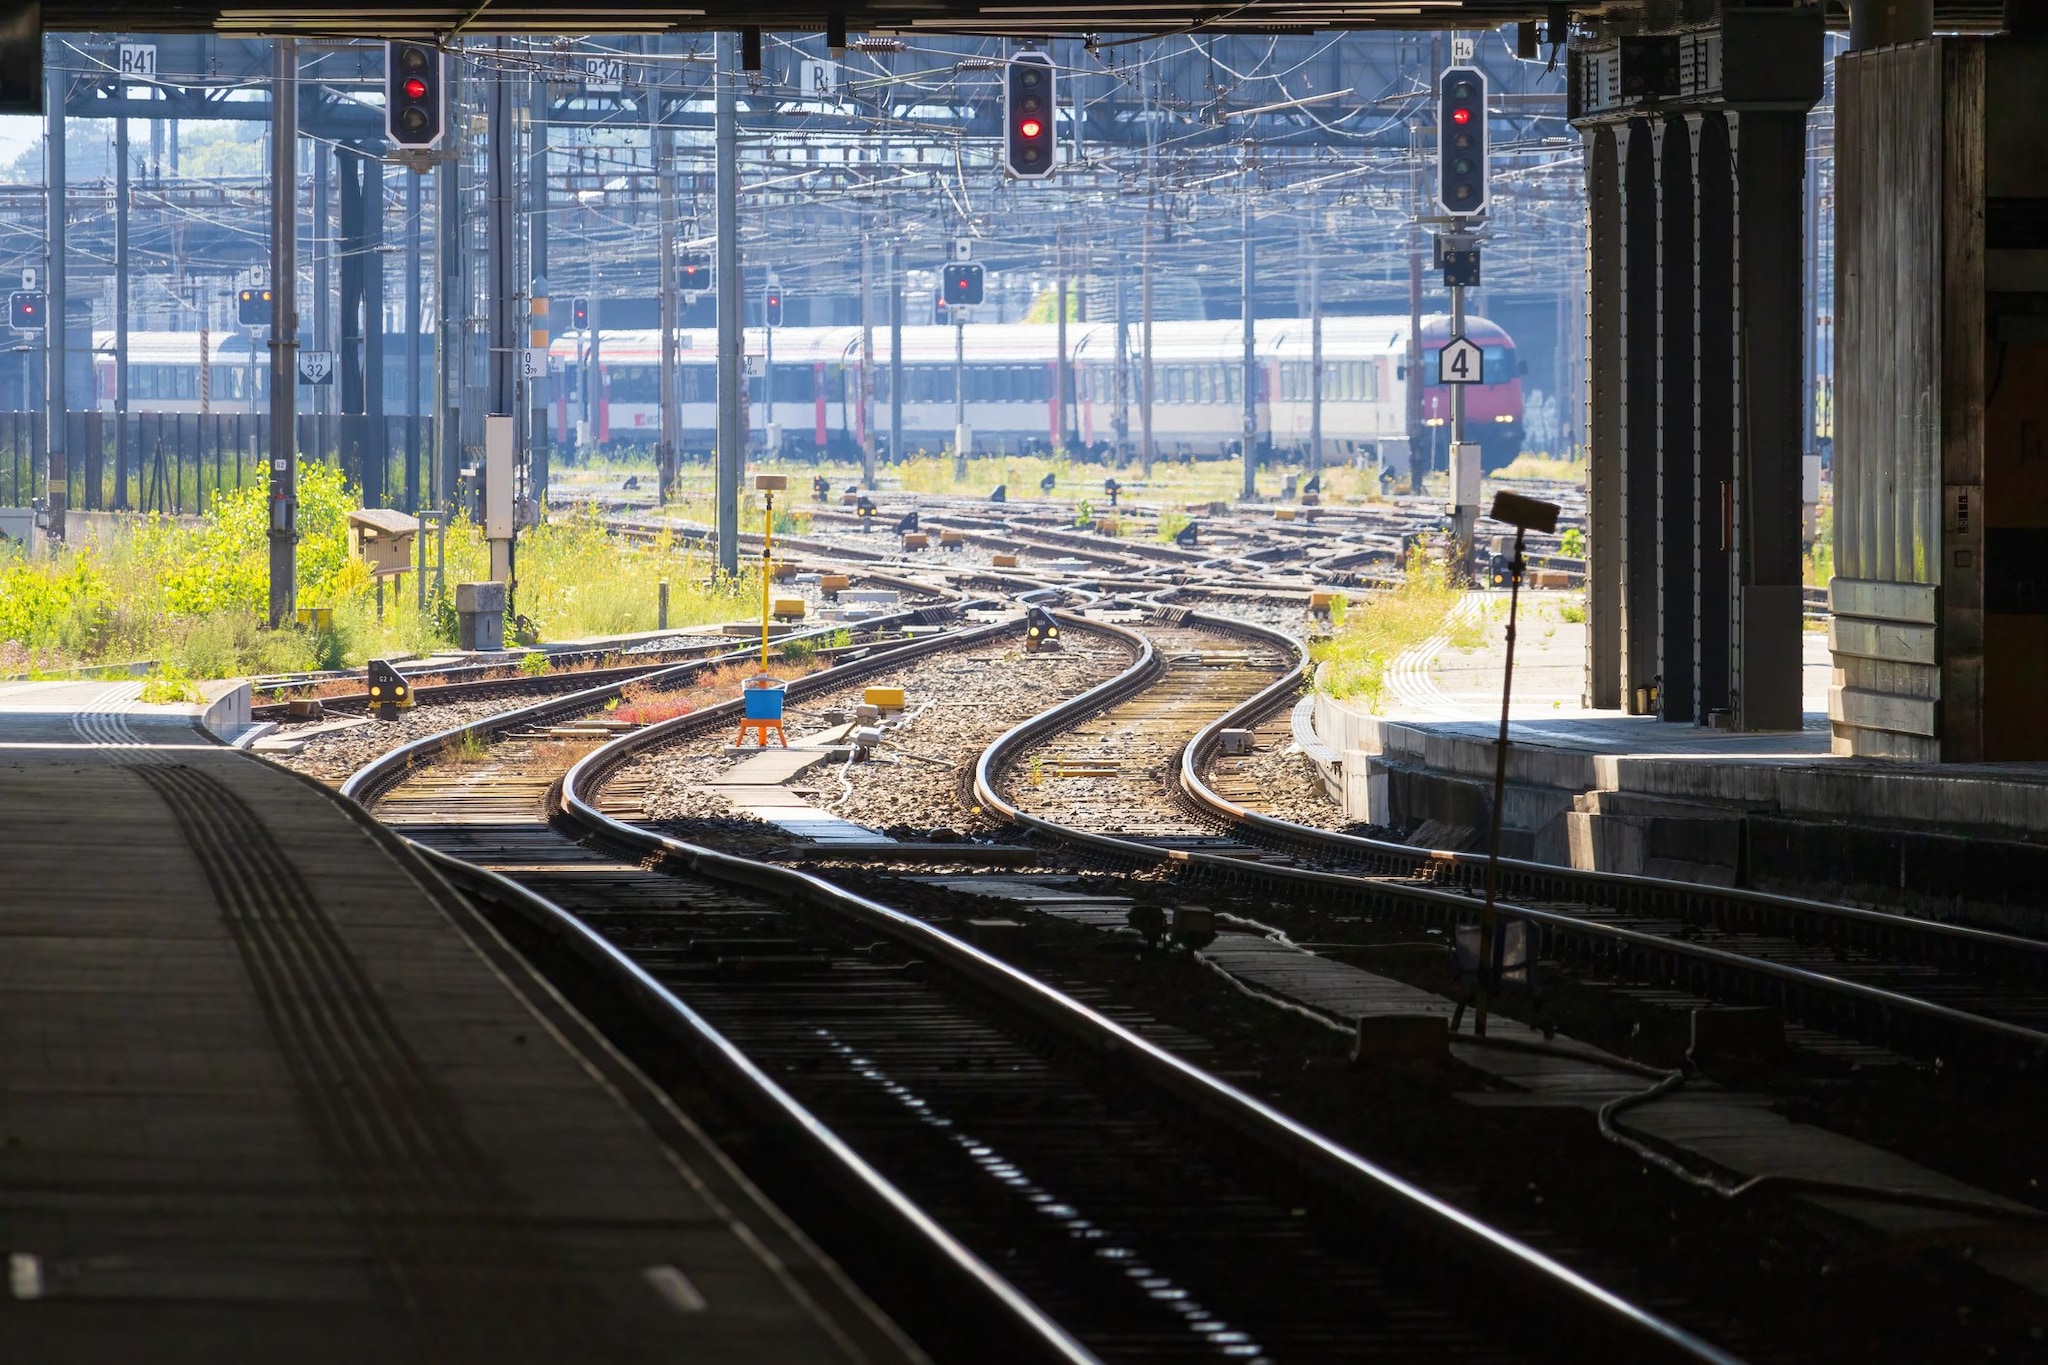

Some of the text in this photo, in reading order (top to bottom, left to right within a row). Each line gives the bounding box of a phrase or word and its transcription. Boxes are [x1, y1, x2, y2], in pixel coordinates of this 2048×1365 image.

[1455, 41, 1471, 56] H4
[122, 50, 154, 73] R41
[587, 61, 621, 84] R34
[307, 354, 324, 363] 317
[1451, 348, 1469, 378] 4
[307, 364, 323, 378] 32
[524, 363, 538, 375] 379
[378, 675, 387, 683] G2
